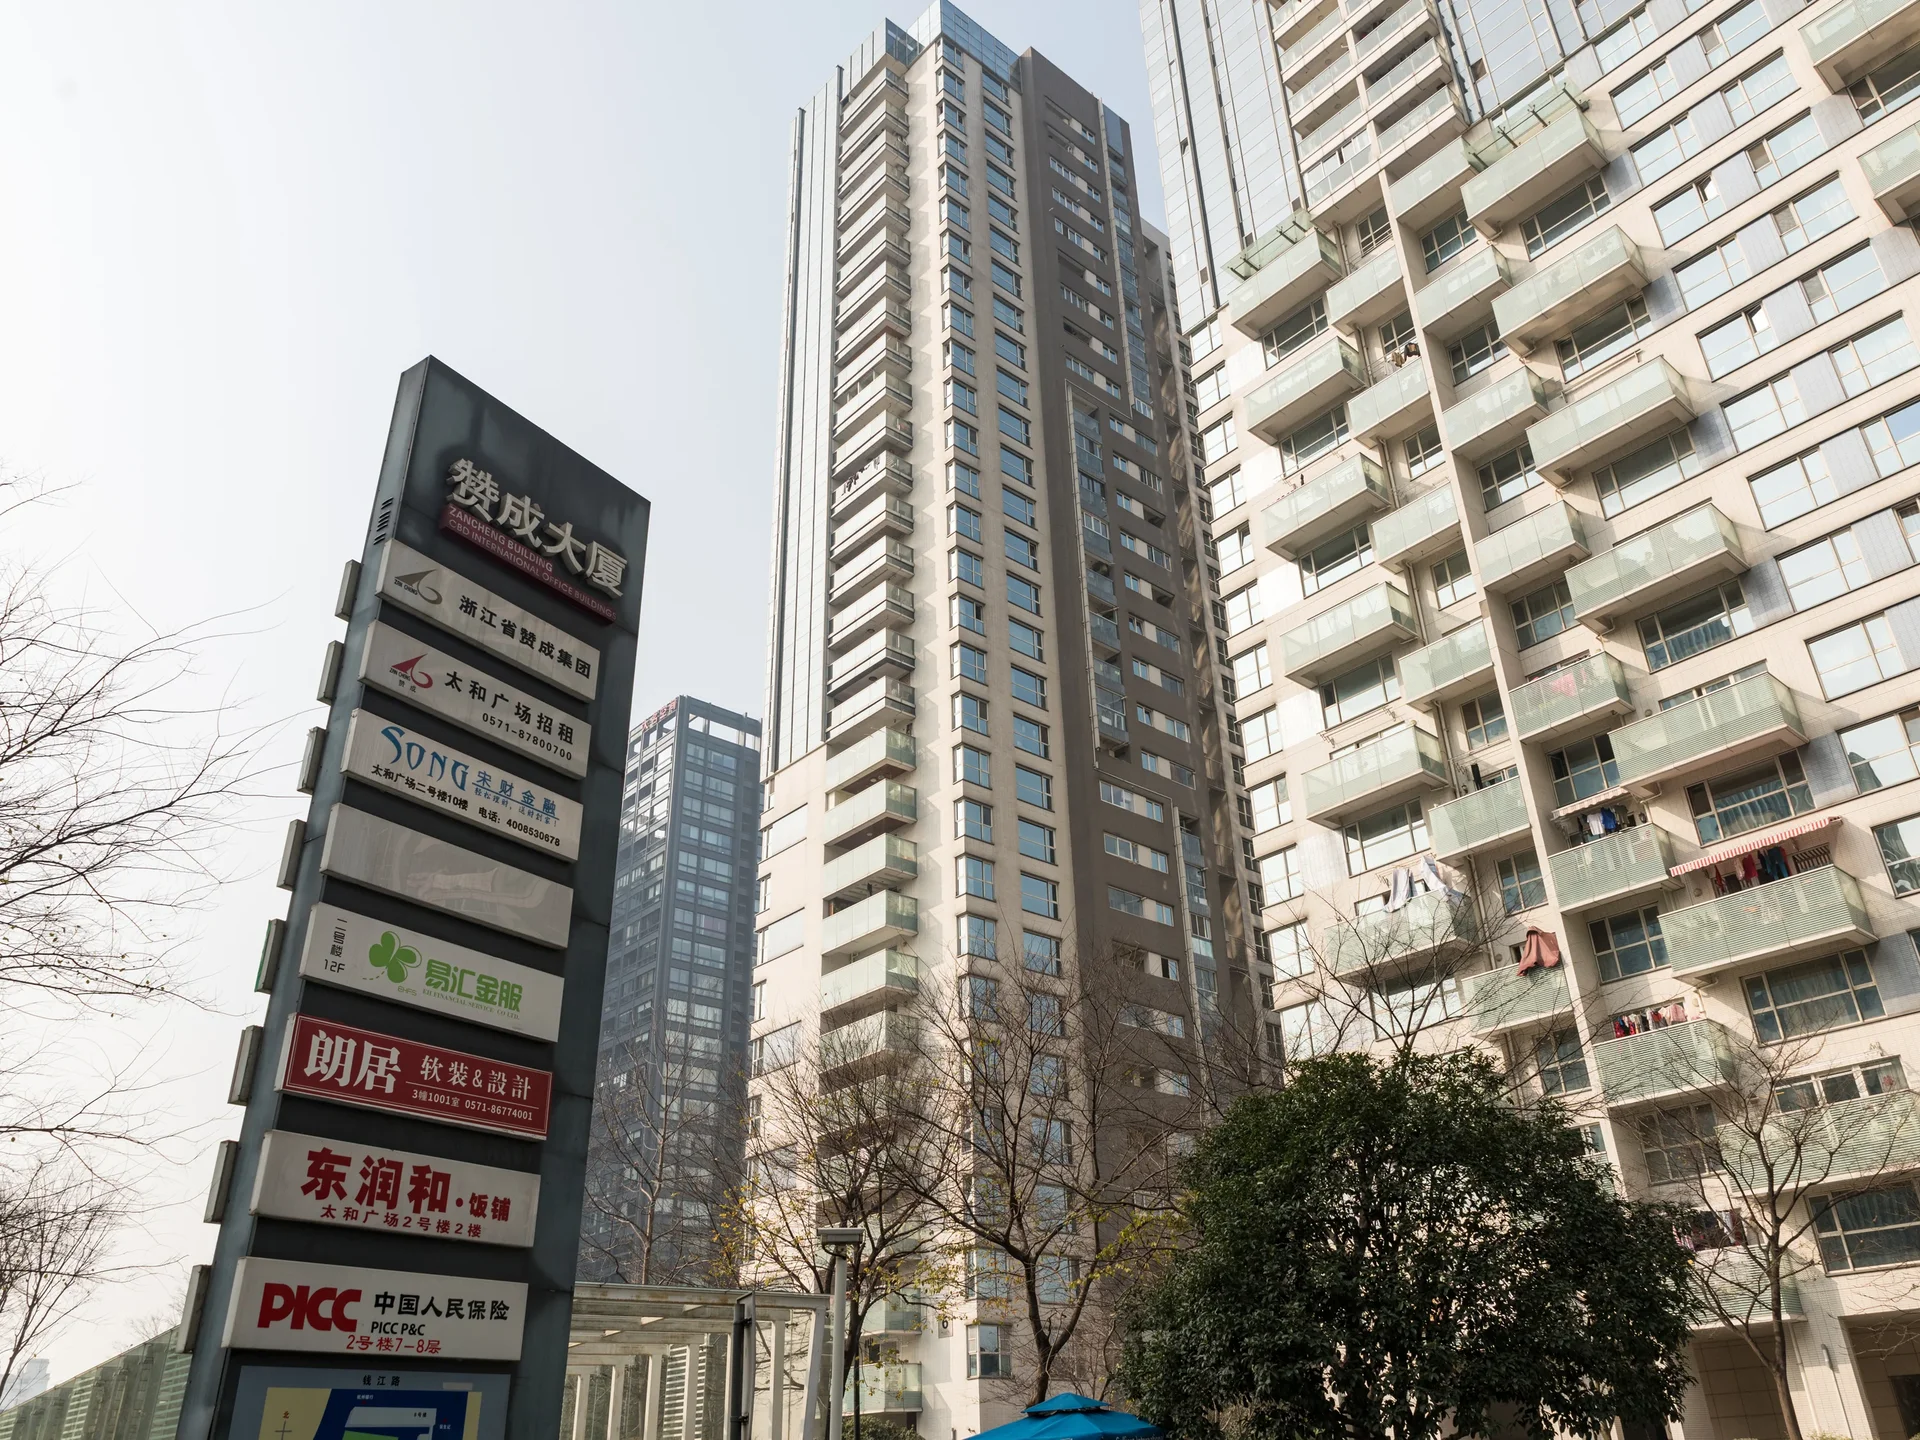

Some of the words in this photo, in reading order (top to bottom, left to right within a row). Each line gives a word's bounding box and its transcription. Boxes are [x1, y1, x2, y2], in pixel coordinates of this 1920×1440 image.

[448, 458, 627, 597] 赞成大厦
[449, 505, 505, 545] ZANCHENG
[507, 540, 553, 573] BUILDING
[449, 519, 470, 536] CBD
[471, 532, 540, 577] INTERNATIONAL
[542, 572, 573, 596] OFFICE
[574, 590, 617, 620] BUILDINGS
[459, 595, 591, 679] 浙江省赞成集团
[444, 671, 574, 745] 太和广场招租
[381, 726, 470, 791] SONG
[482, 713, 572, 760] 0571-87800700
[371, 764, 469, 811] 太和广场二号楼10楼
[506, 819, 560, 847] 4008530678
[476, 771, 557, 817] 宋财金融
[324, 958, 346, 973] 12F
[425, 959, 523, 1012] 易汇金服
[397, 985, 417, 997] EHFS
[433, 991, 467, 1006] FINANCIAL
[468, 1001, 495, 1014] SERVICE
[304, 1029, 401, 1093] 朗居
[465, 1100, 533, 1121] 0571-86774001
[320, 1204, 482, 1238] 太和广场2号楼2楼
[257, 1282, 362, 1332] PICC
[371, 1321, 398, 1334] PICC
[401, 1323, 425, 1336] P&C
[374, 1291, 510, 1320] 中国人民保险
[362, 1374, 400, 1387] 钱江路
